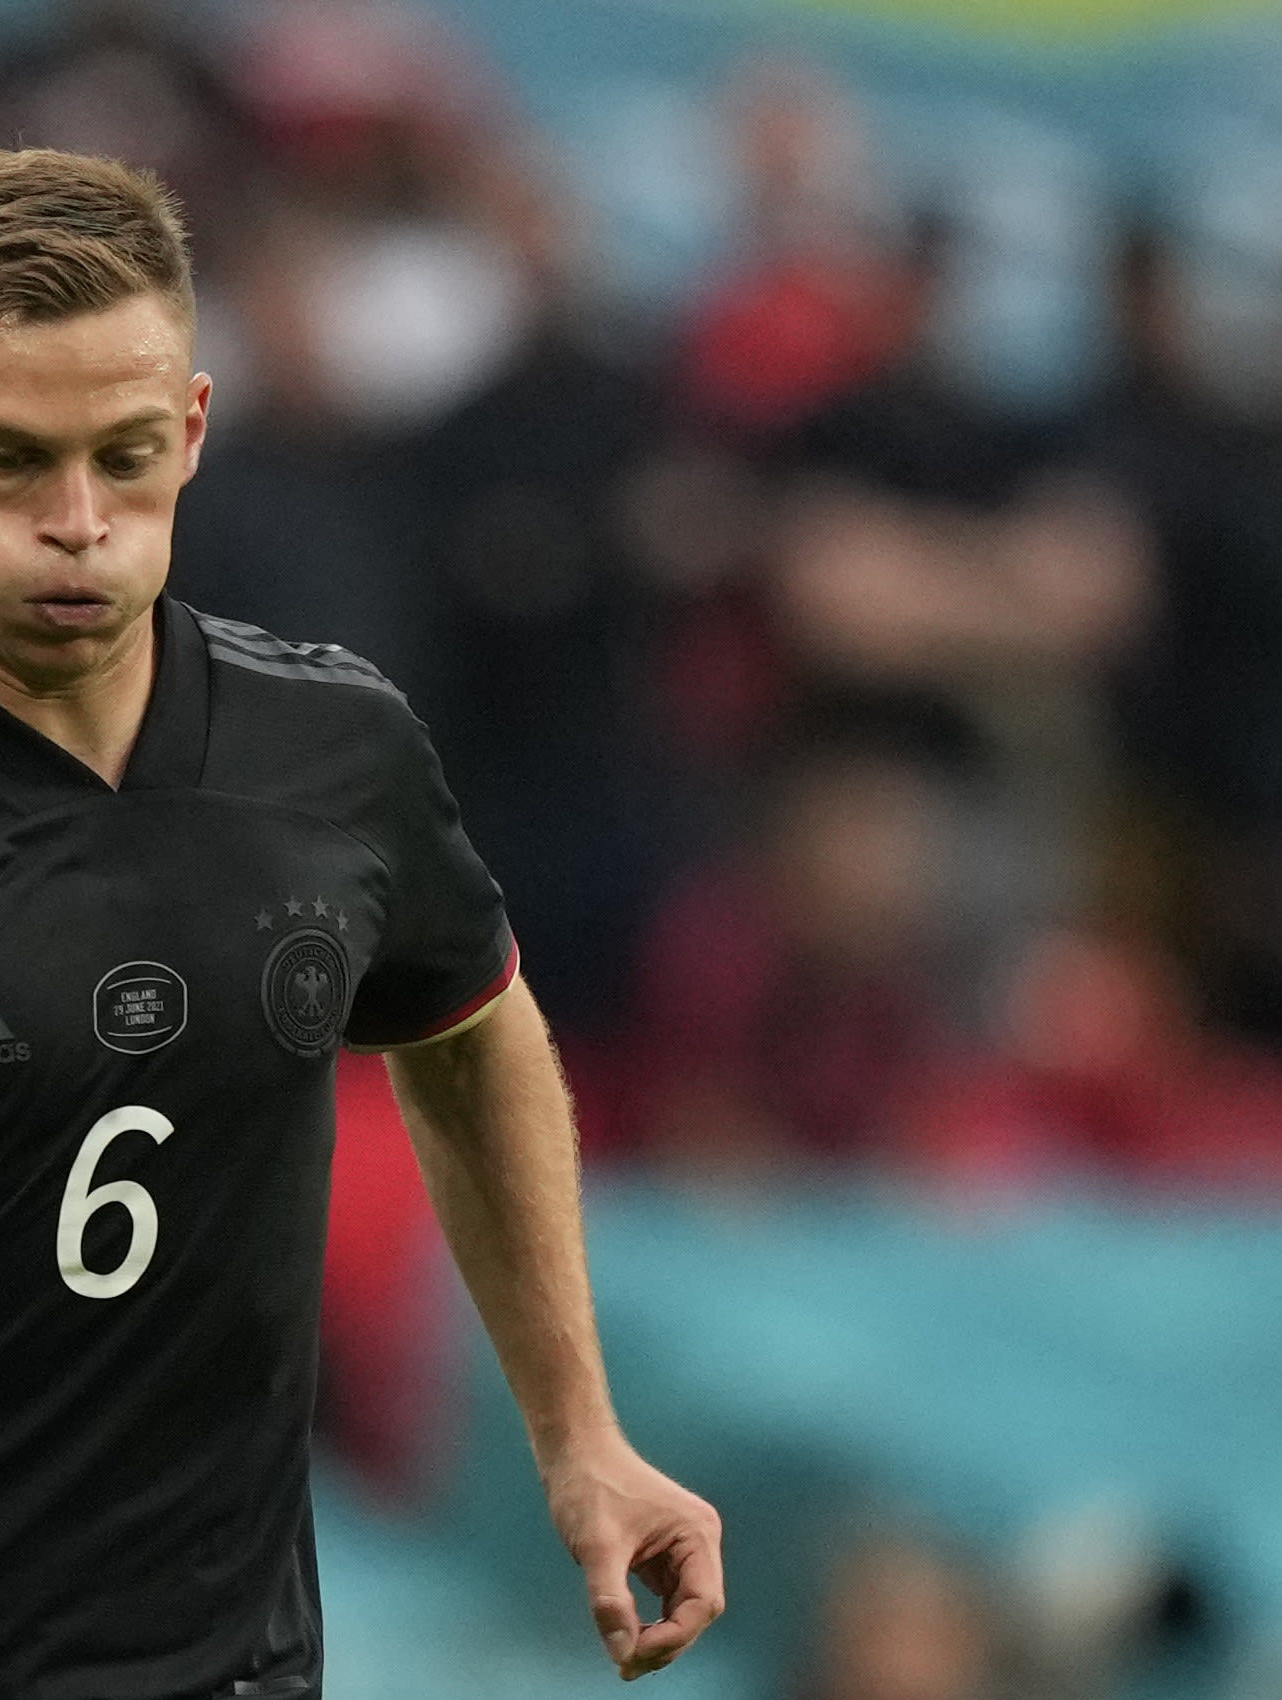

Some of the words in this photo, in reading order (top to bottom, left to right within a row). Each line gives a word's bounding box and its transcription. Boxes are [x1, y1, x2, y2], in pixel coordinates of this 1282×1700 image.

[121, 989, 156, 1002] ENGLAND
[125, 1003, 146, 1014] JUNE
[147, 1001, 164, 1012] 2021
[125, 1013, 156, 1026] LONDON
[55, 1104, 176, 1301] 6
